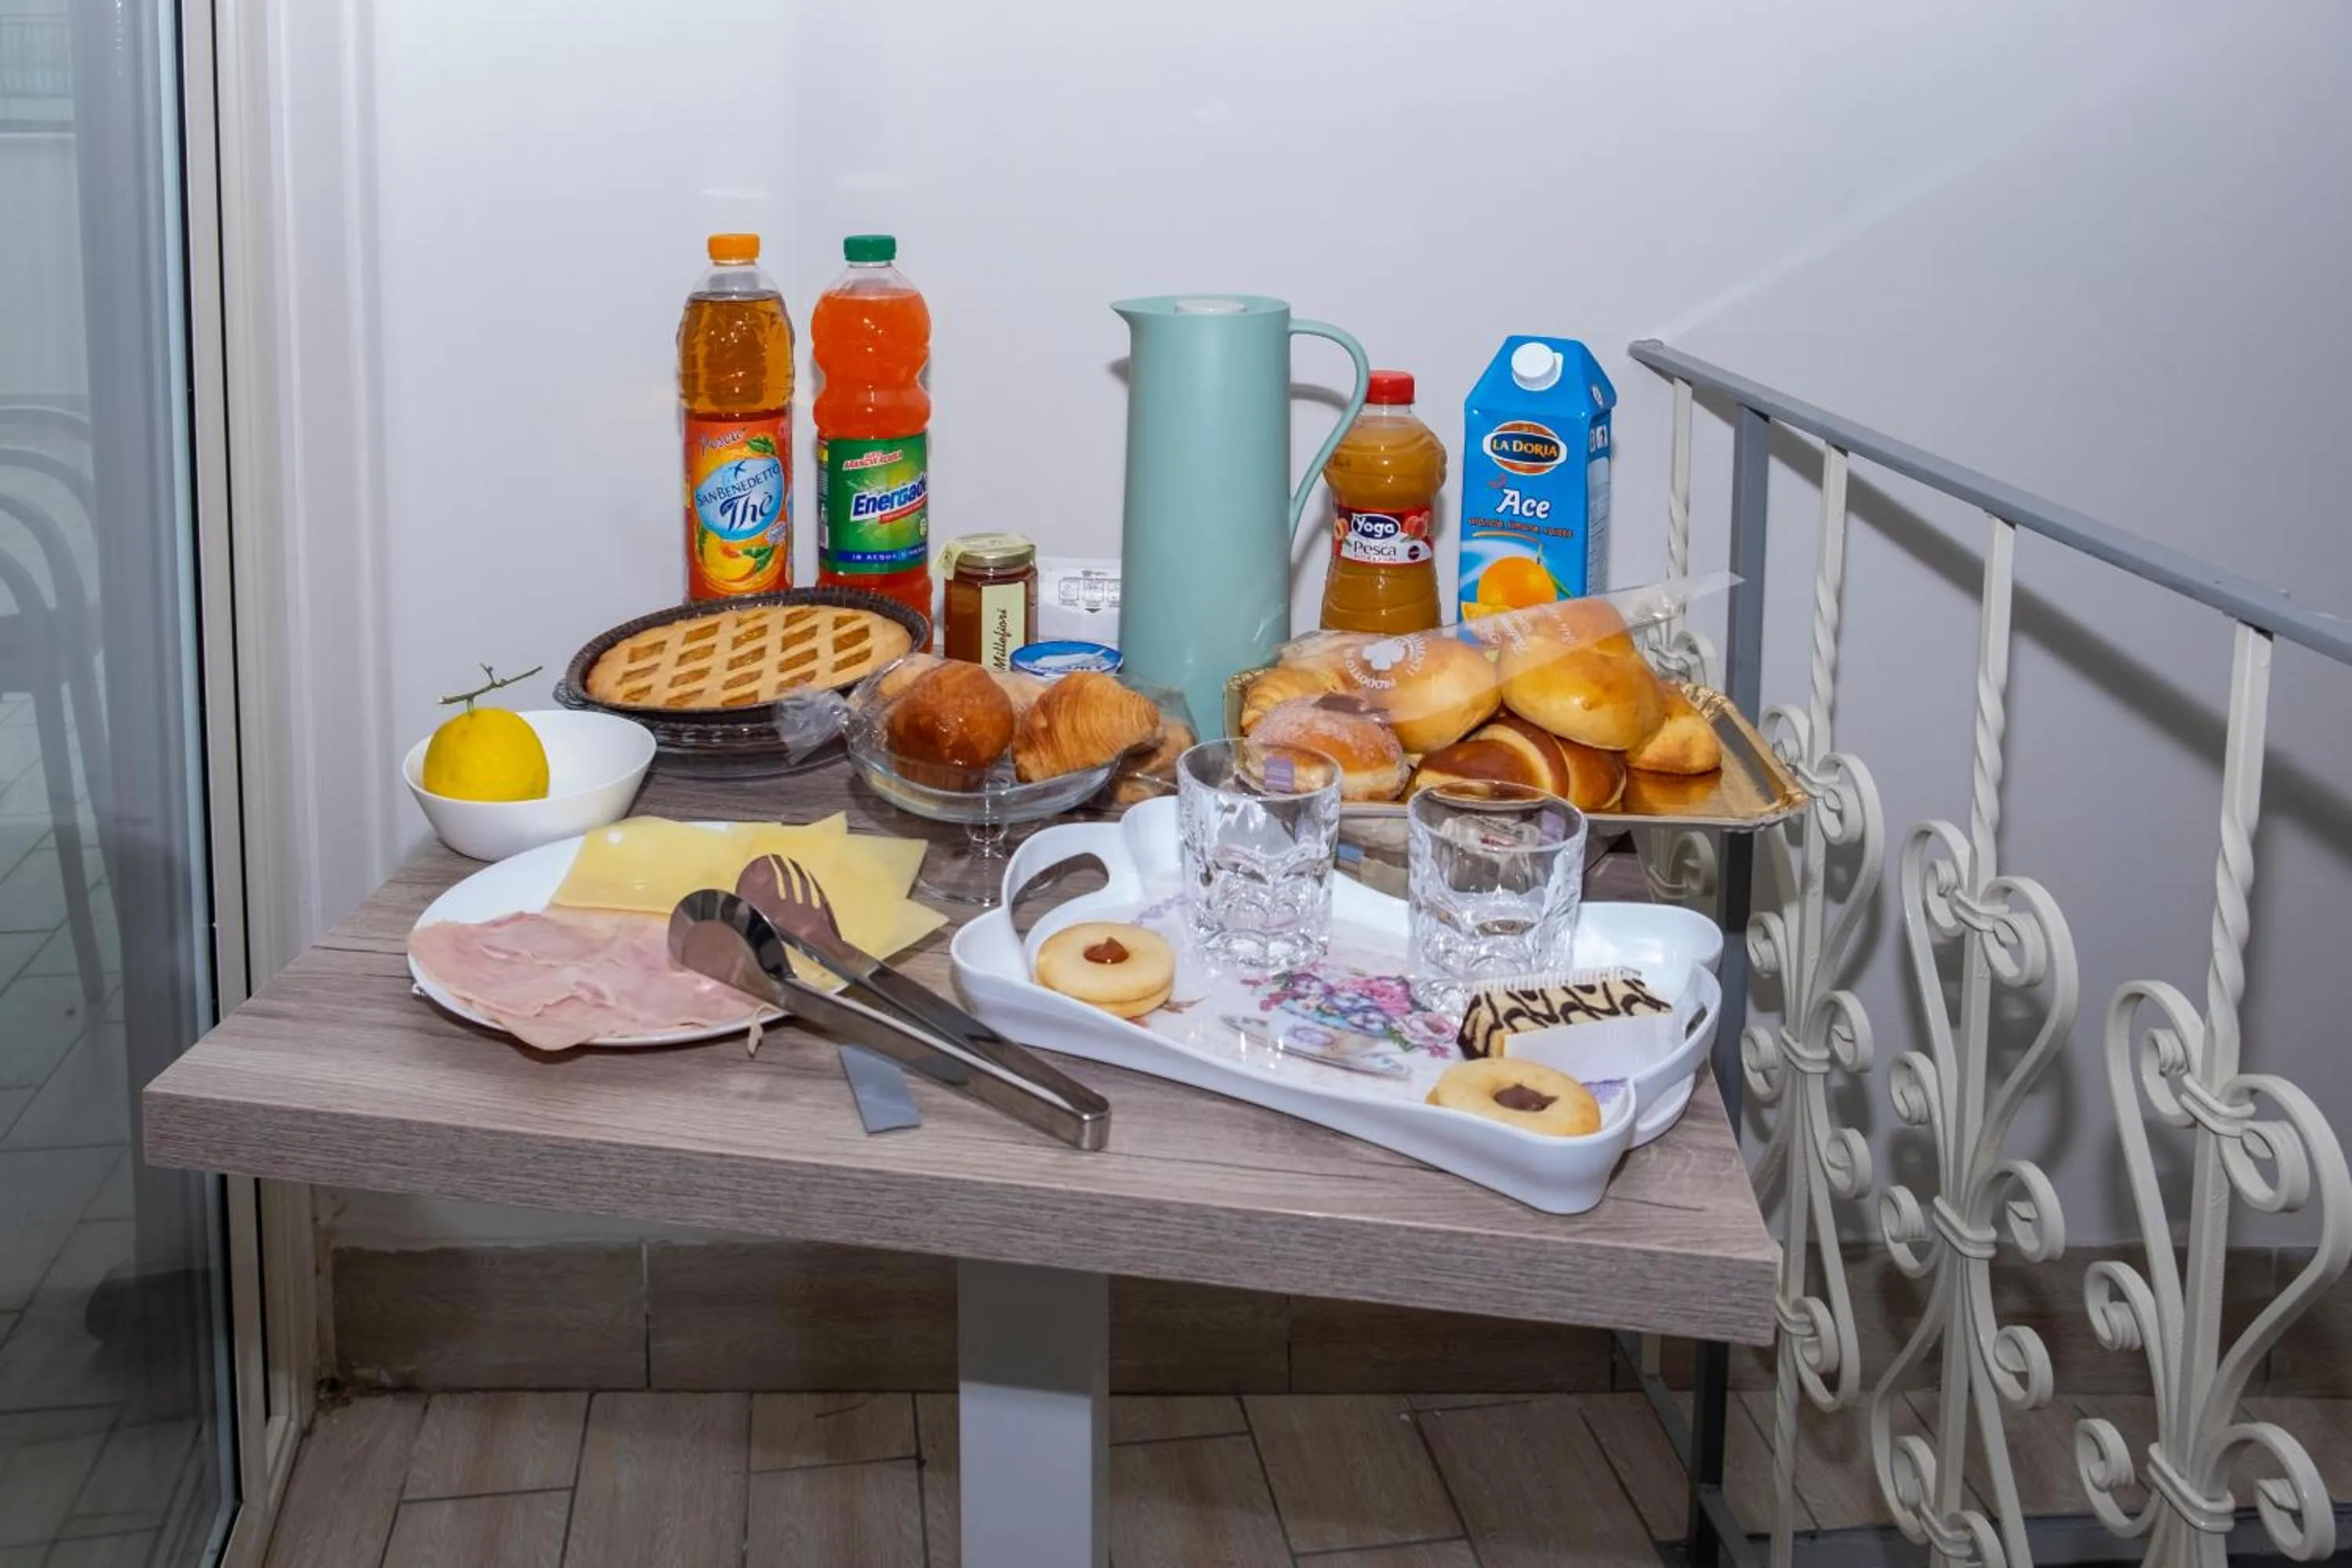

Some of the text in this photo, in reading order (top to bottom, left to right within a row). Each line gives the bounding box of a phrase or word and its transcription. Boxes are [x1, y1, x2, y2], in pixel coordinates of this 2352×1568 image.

[1492, 439, 1557, 458] LA DORIA
[1496, 488, 1550, 519] Ace
[1356, 517, 1395, 538] Yoga
[1354, 540, 1396, 556] Pesca
[993, 608, 1012, 670] Millefiori
